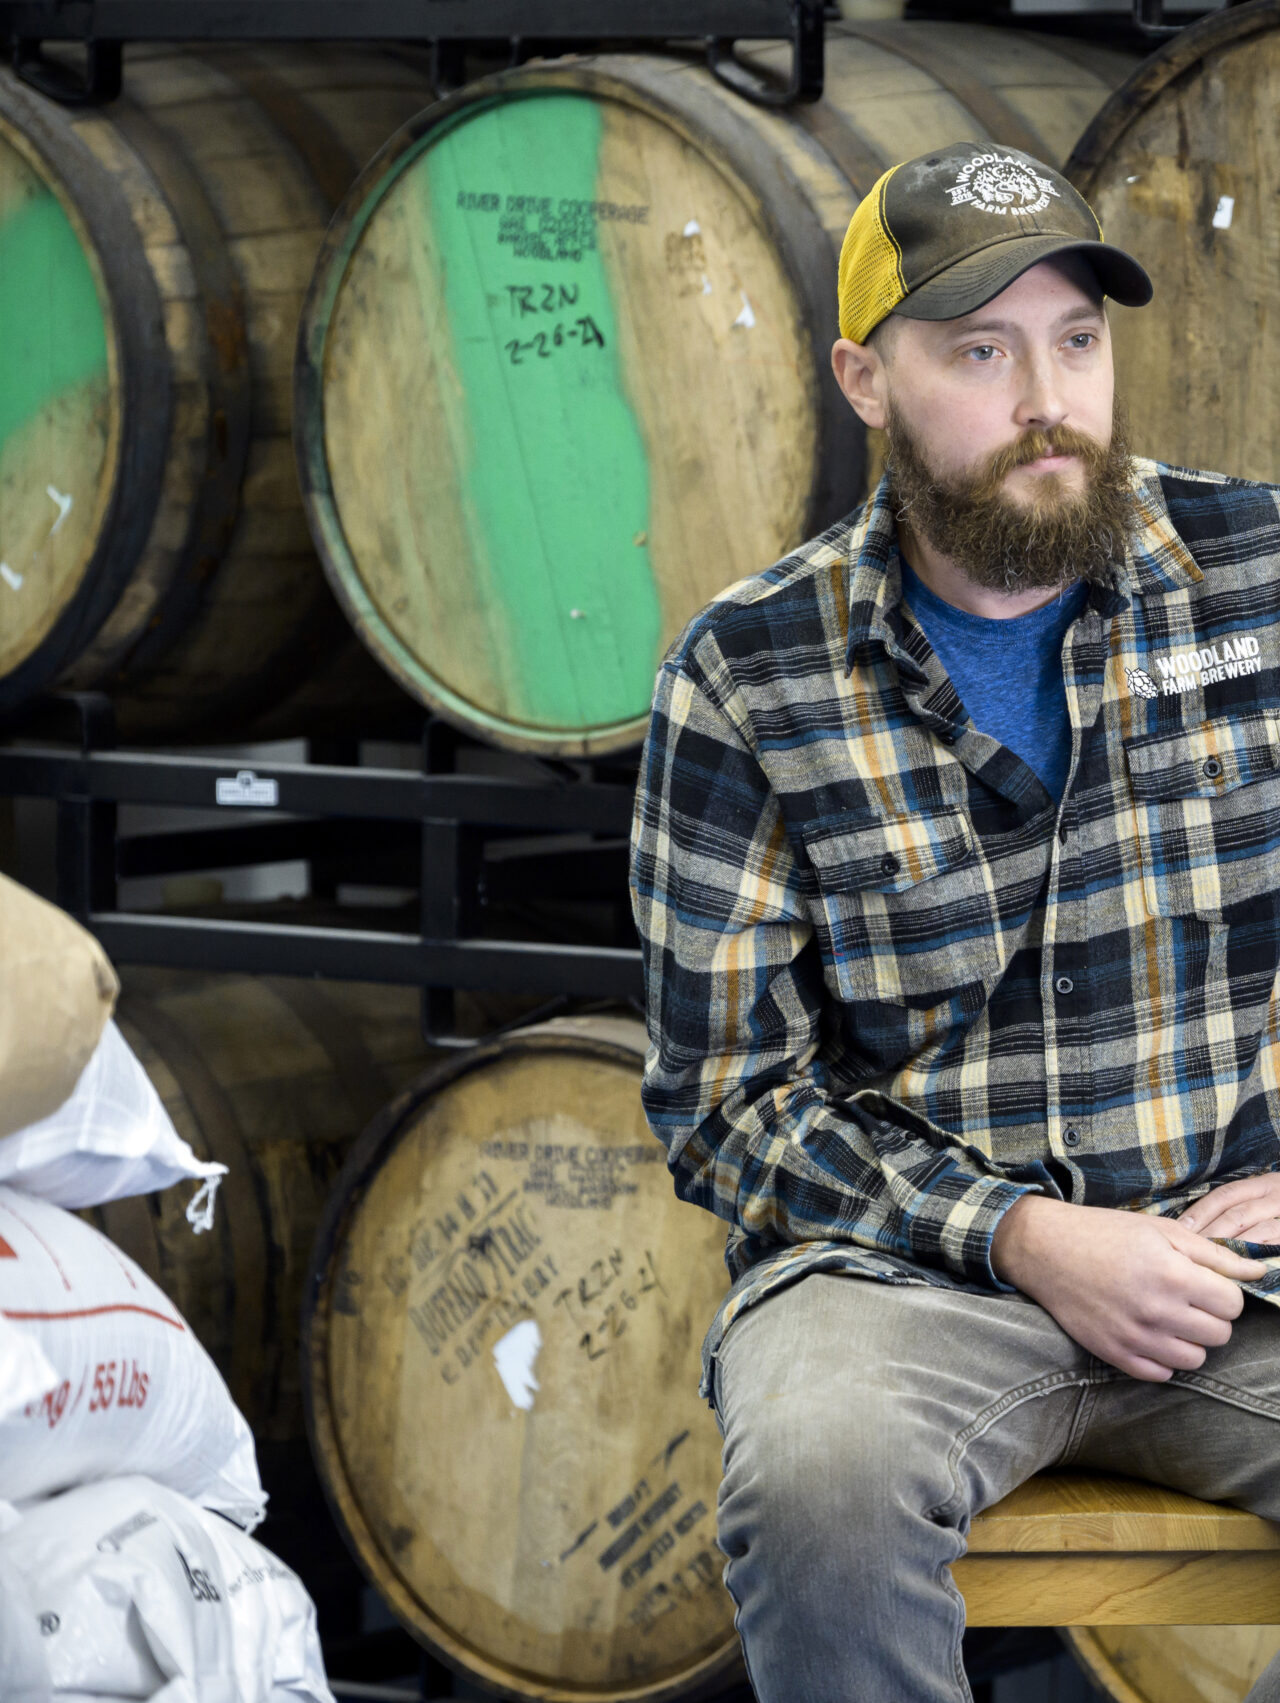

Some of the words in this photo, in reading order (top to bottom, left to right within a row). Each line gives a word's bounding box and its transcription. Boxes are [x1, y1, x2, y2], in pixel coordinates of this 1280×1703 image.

[956, 153, 1037, 183] WOODLAND
[970, 199, 1007, 215] FARM
[1156, 636, 1261, 679] WOODLAND
[1162, 674, 1197, 696] FARM
[1199, 656, 1262, 687] BREWERY
[89, 1360, 117, 1413] 55
[117, 1358, 149, 1410] Lbs
